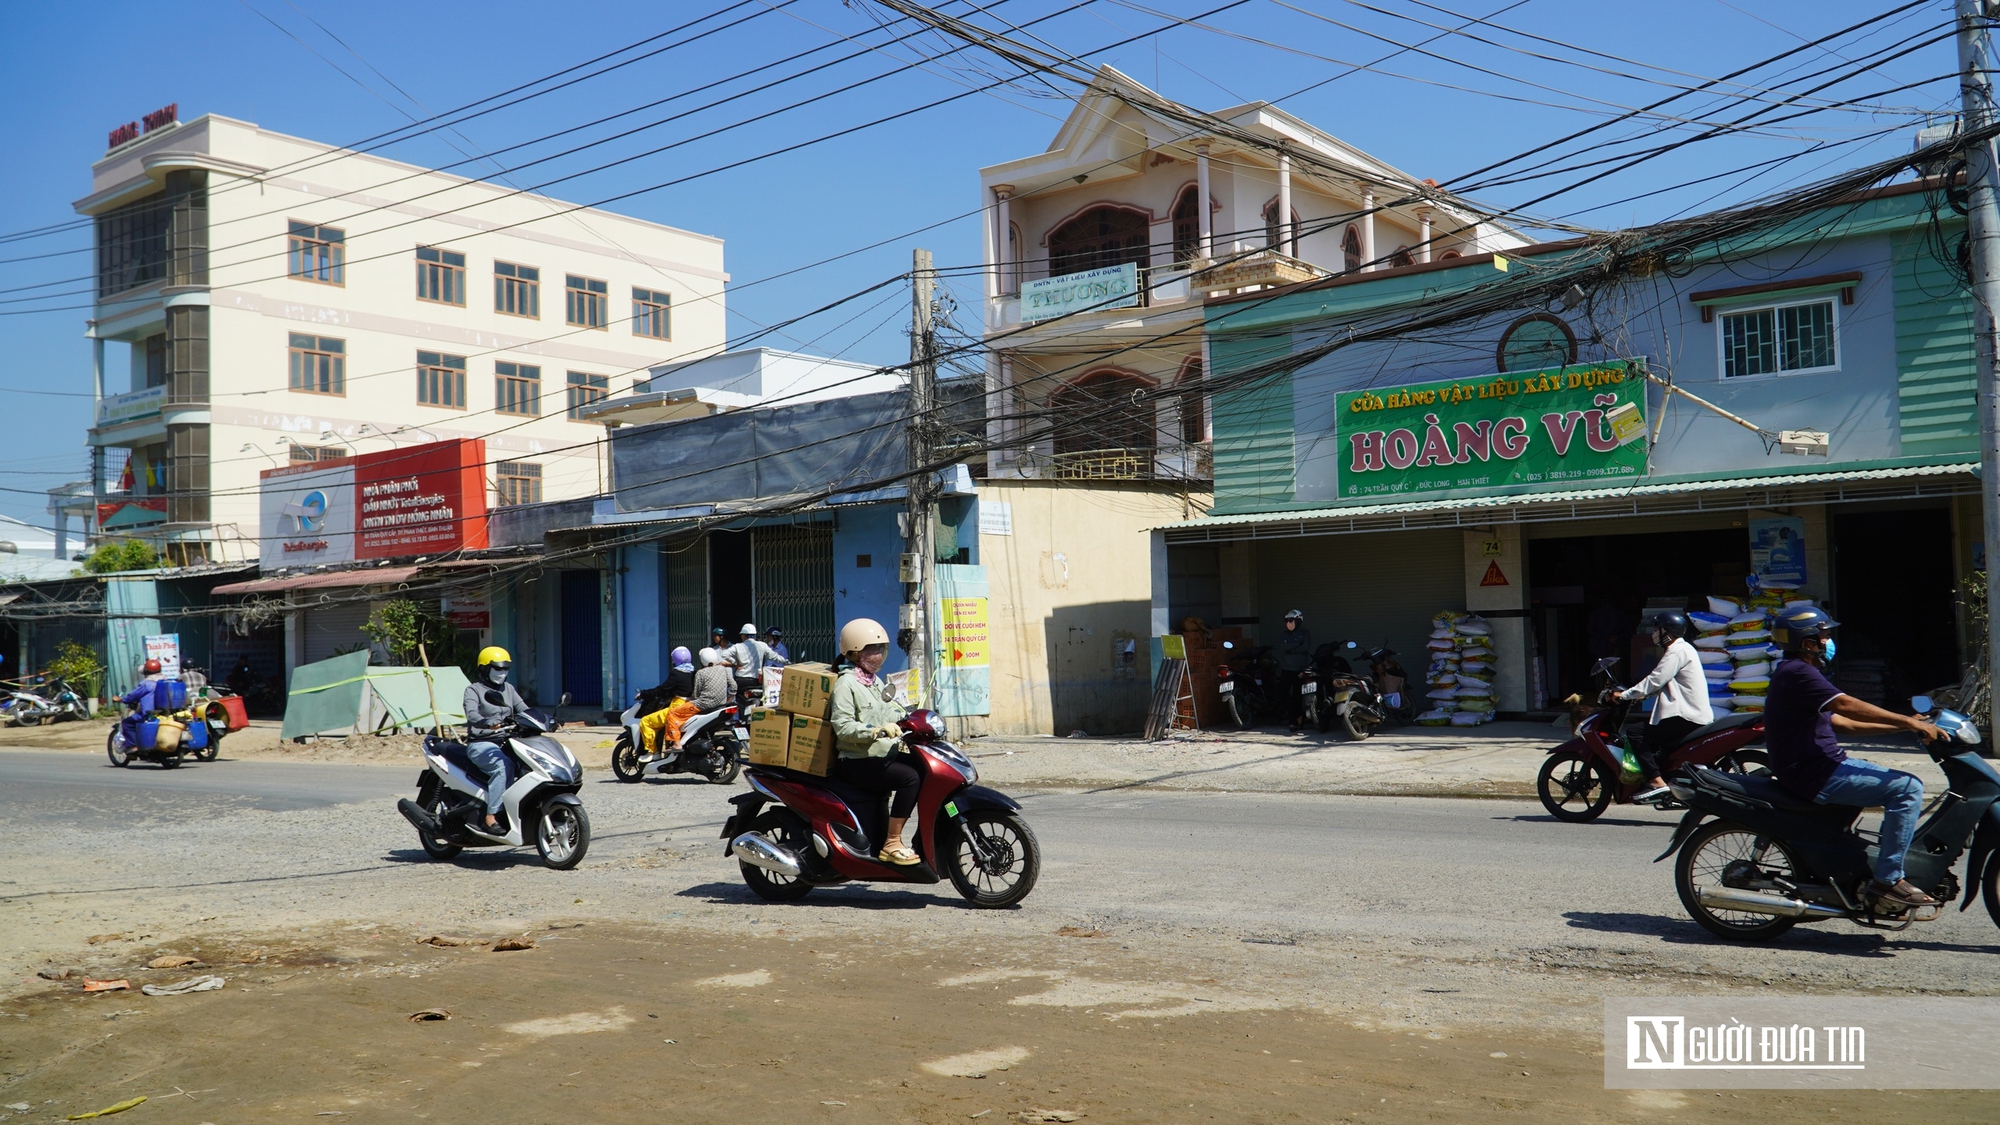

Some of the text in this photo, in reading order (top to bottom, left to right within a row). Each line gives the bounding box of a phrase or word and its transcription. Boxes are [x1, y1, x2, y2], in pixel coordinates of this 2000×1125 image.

[1057, 275, 1069, 284] VẬT
[1071, 273, 1085, 282] LIỆU
[1087, 270, 1100, 279] XÂY
[1351, 368, 1625, 413] CỬA HÀNG VẬT LIỆU XÂY DỰNG
[1350, 413, 1530, 473] HOÀNG
[1541, 392, 1621, 453] VŨ
[1549, 469, 1582, 479] 3819.219
[1586, 466, 1635, 476] 0909.177.689
[363, 476, 419, 497] NHÀ PHÂN PHỐI
[1373, 483, 1389, 493] TRẦN
[1471, 474, 1490, 485] THIẾT
[363, 493, 445, 513] DẦU NHỚT TotalEnergies
[363, 505, 453, 529] DNTN TM DV HỒNG NHÂN
[283, 540, 329, 553] TotalEnergies
[1486, 542, 1499, 551] 74
[1483, 568, 1504, 584] Sika
[962, 619, 974, 629] CUỐI
[952, 632, 965, 643] TRẦN
